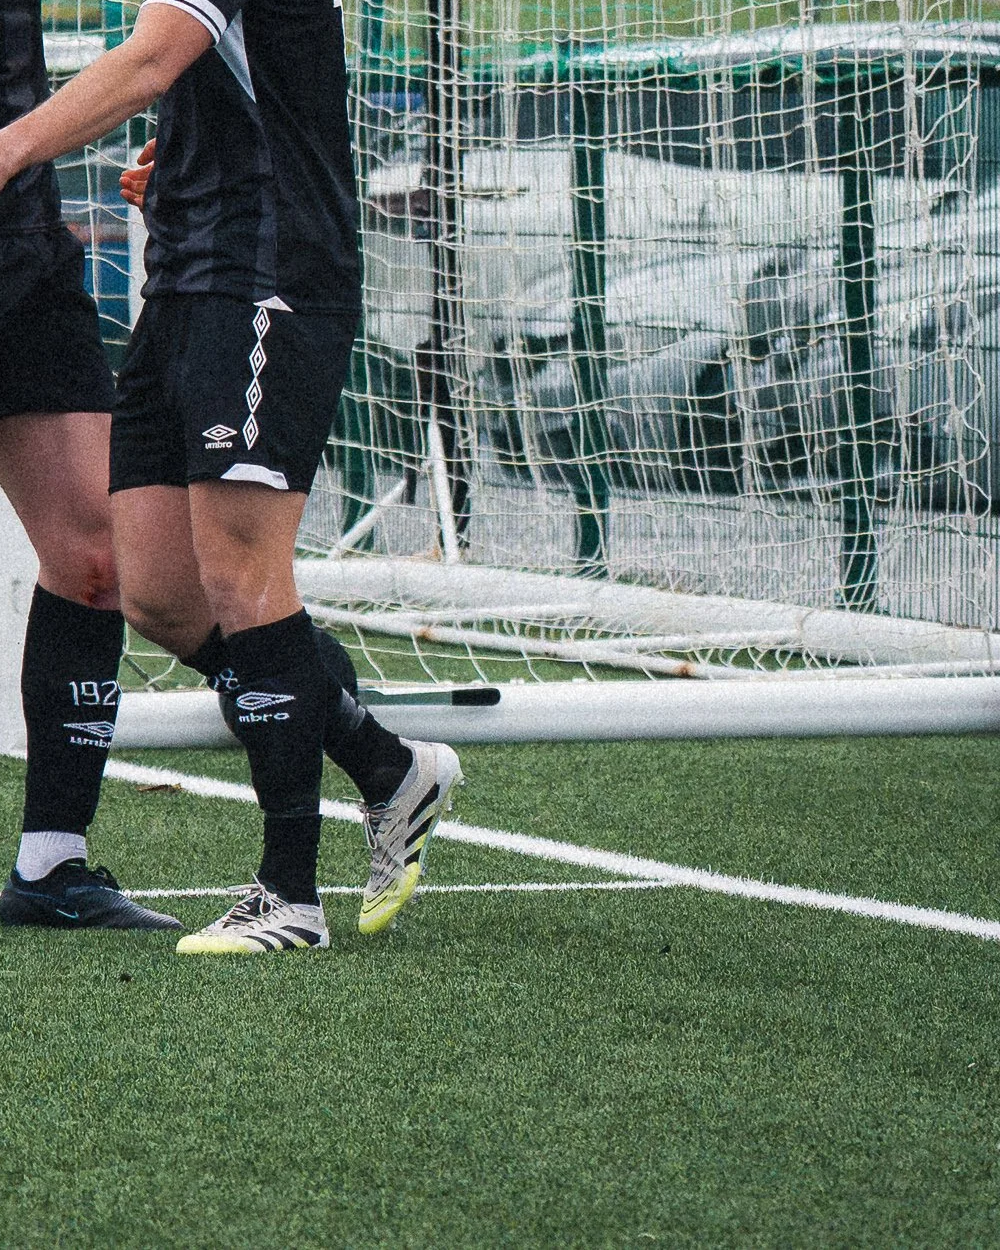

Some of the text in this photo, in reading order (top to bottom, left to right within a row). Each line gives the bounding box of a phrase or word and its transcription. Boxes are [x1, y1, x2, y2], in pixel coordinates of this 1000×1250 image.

[205, 440, 232, 449] umbro
[69, 680, 121, 706] 192
[239, 711, 290, 723] mbro
[69, 735, 111, 748] umbr
